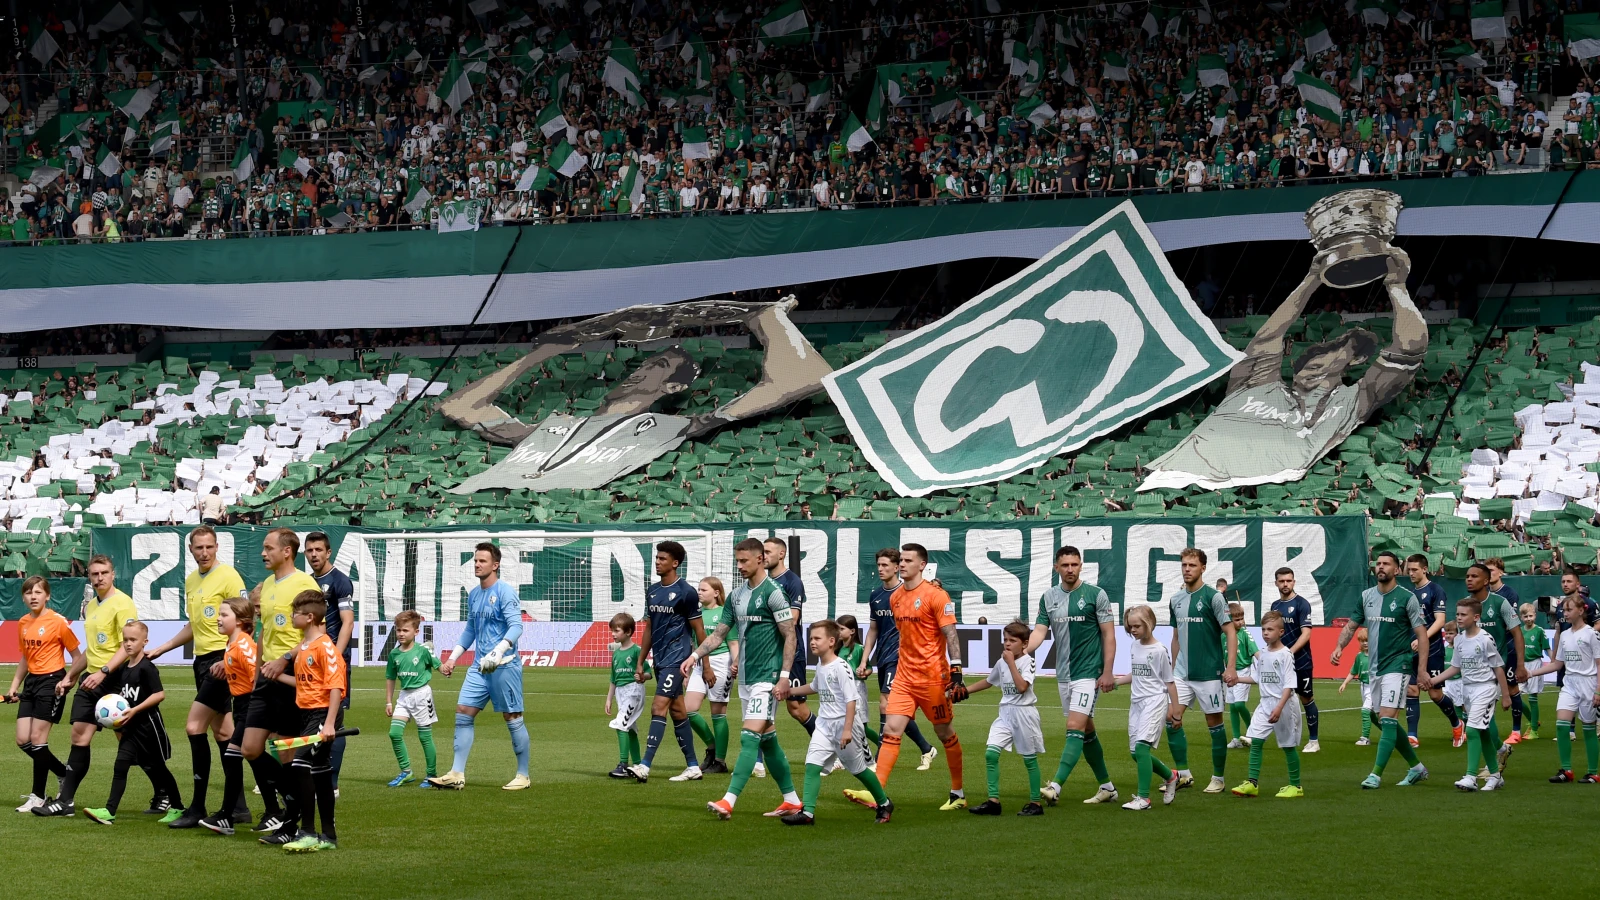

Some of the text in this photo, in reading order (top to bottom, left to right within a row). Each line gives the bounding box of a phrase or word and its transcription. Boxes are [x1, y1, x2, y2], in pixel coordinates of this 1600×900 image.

[12, 17, 20, 46] 139
[19, 357, 37, 368] 138
[296, 530, 551, 621] AHRE
[649, 604, 675, 614] ONOVIA
[777, 610, 790, 619] SVW
[1430, 669, 1440, 679] 31
[1506, 667, 1514, 678] 6
[663, 673, 675, 688] 5
[1303, 677, 1310, 690] 7
[121, 683, 140, 701] sky
[1388, 689, 1396, 703] 3
[750, 698, 762, 713] 32
[1079, 692, 1090, 708] 13
[1209, 693, 1220, 708] 14
[932, 704, 946, 719] 30
